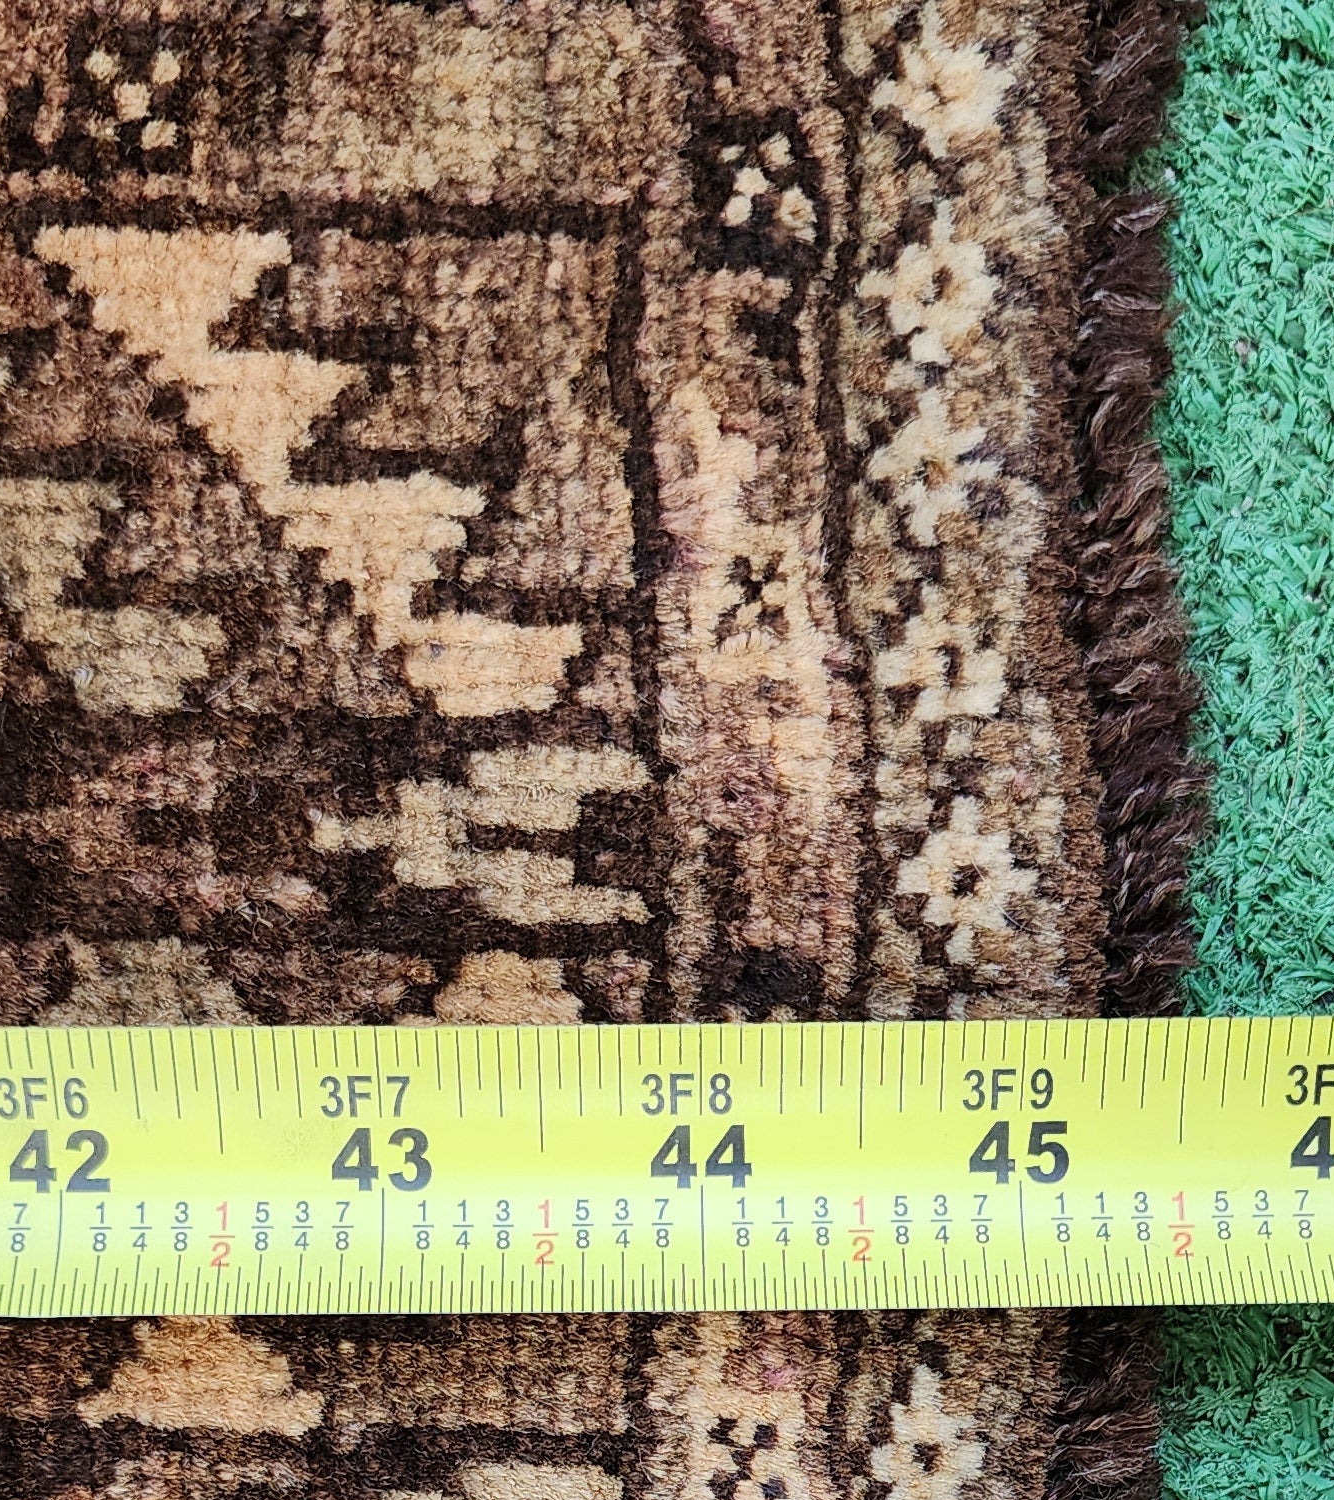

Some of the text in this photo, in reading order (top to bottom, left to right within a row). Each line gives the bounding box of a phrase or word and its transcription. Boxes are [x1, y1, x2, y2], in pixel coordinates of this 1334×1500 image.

[9, 1128, 112, 1194] 42
[331, 1127, 433, 1192] 43
[650, 1124, 752, 1189] 44
[969, 1120, 1069, 1185] 45
